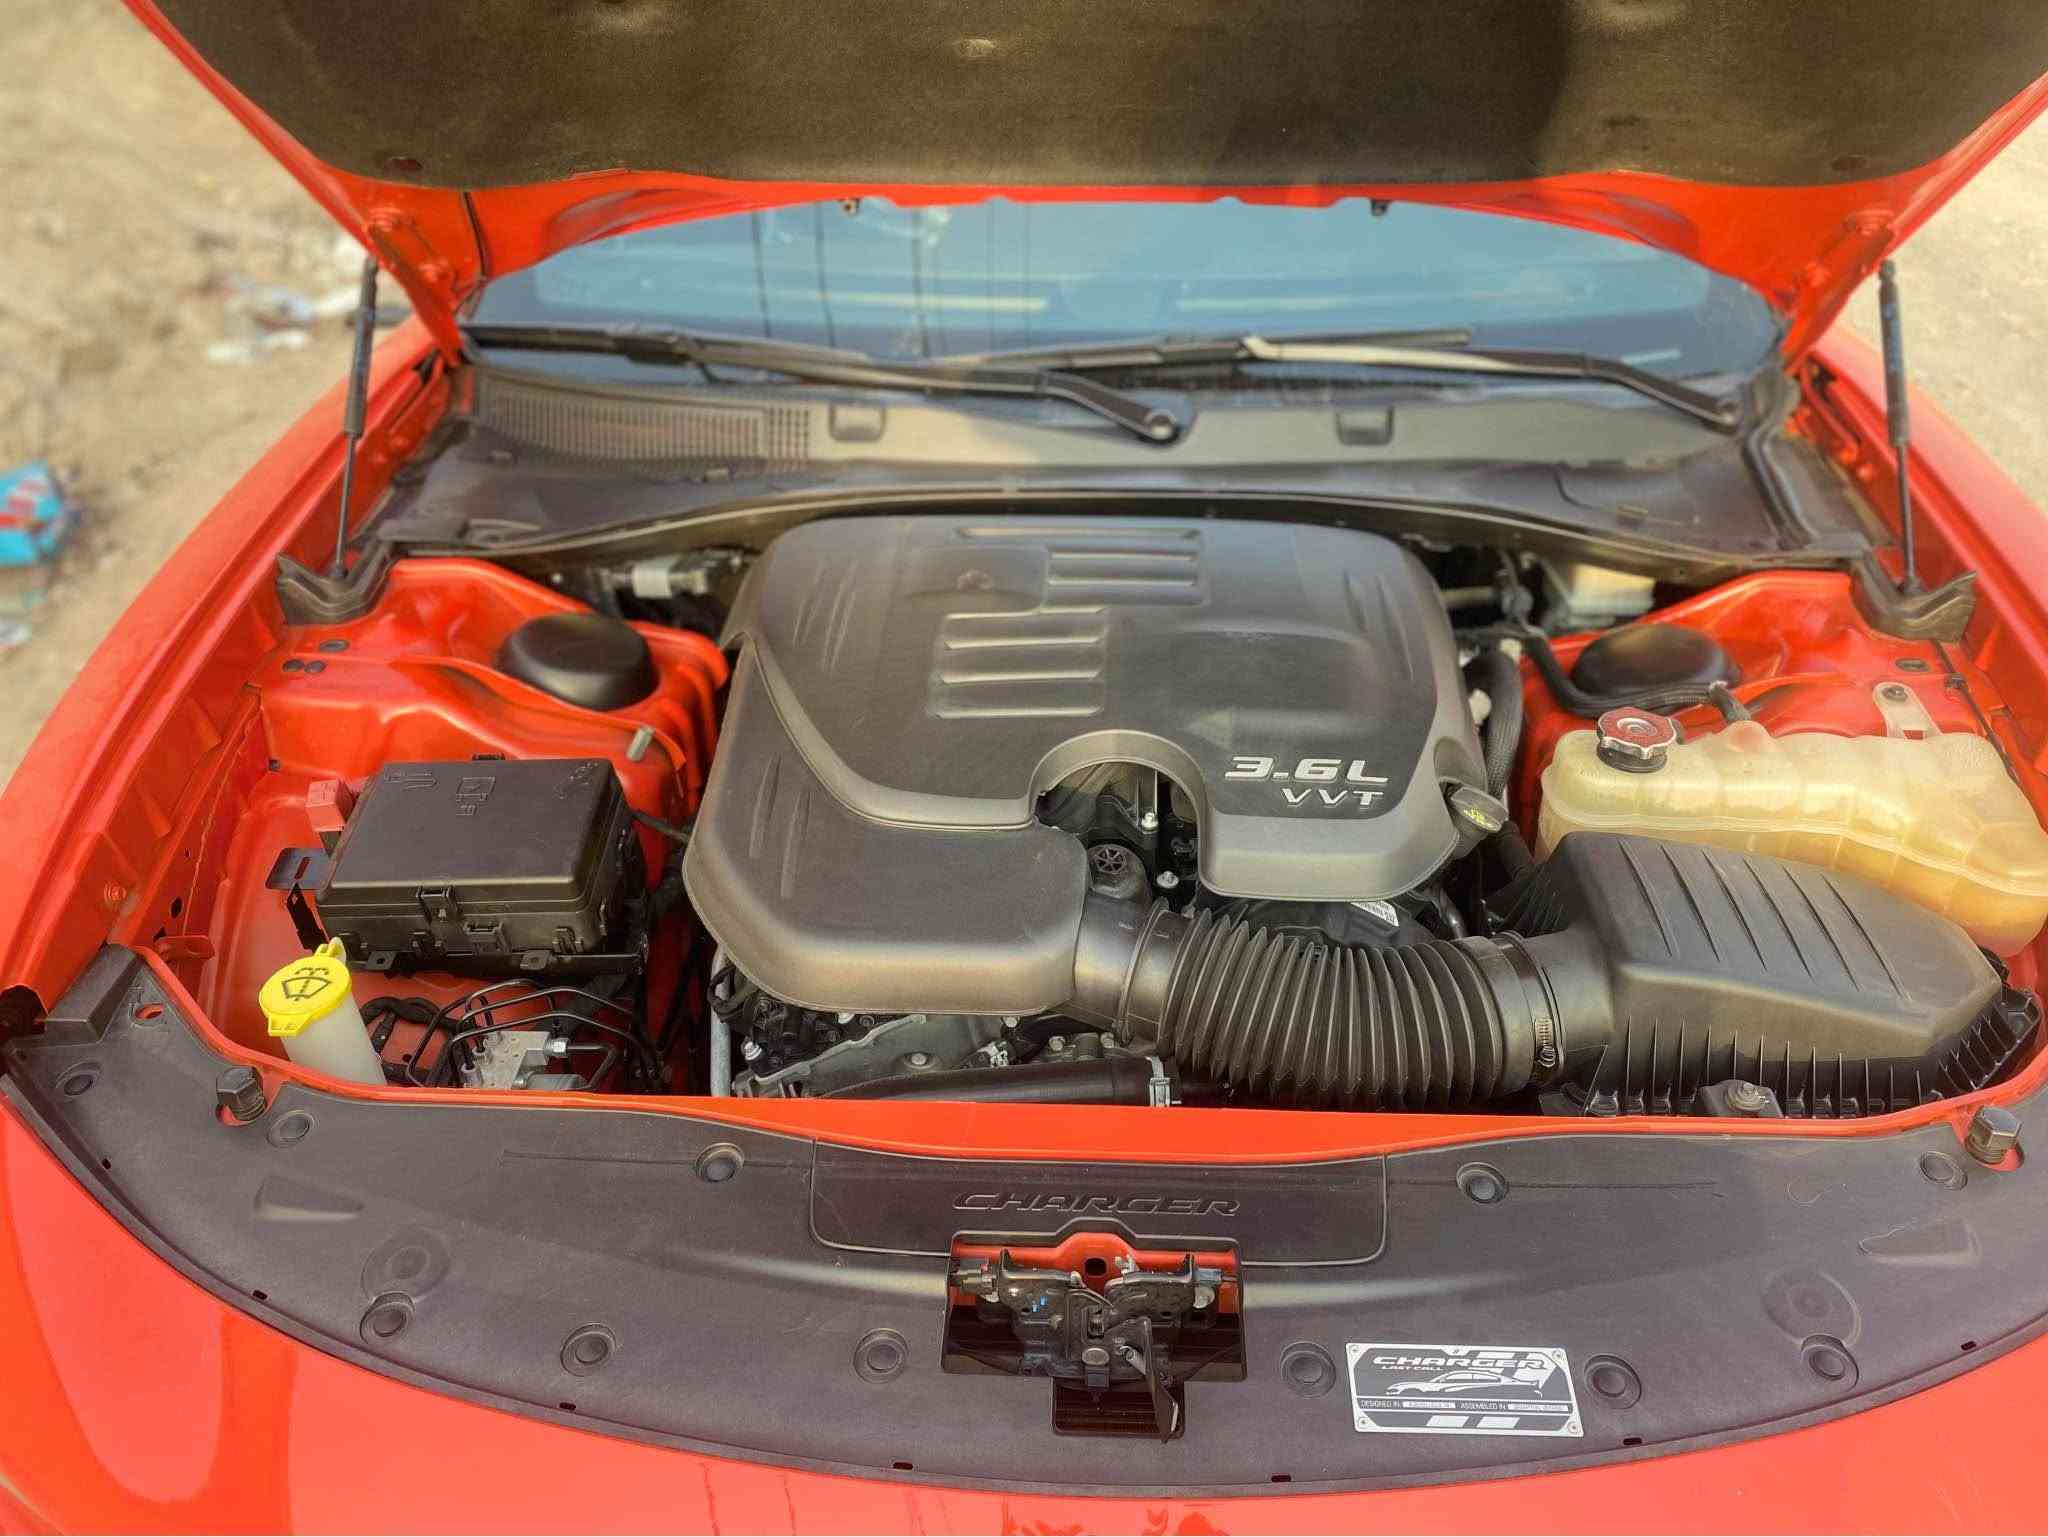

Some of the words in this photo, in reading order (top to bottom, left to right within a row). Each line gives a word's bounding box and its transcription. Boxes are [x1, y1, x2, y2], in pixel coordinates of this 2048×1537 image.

[1225, 755, 1389, 783] 3.6L
[1281, 787, 1385, 808] VVT
[952, 1192, 1241, 1217] CHARGER
[1372, 1356, 1547, 1371] CHARGER
